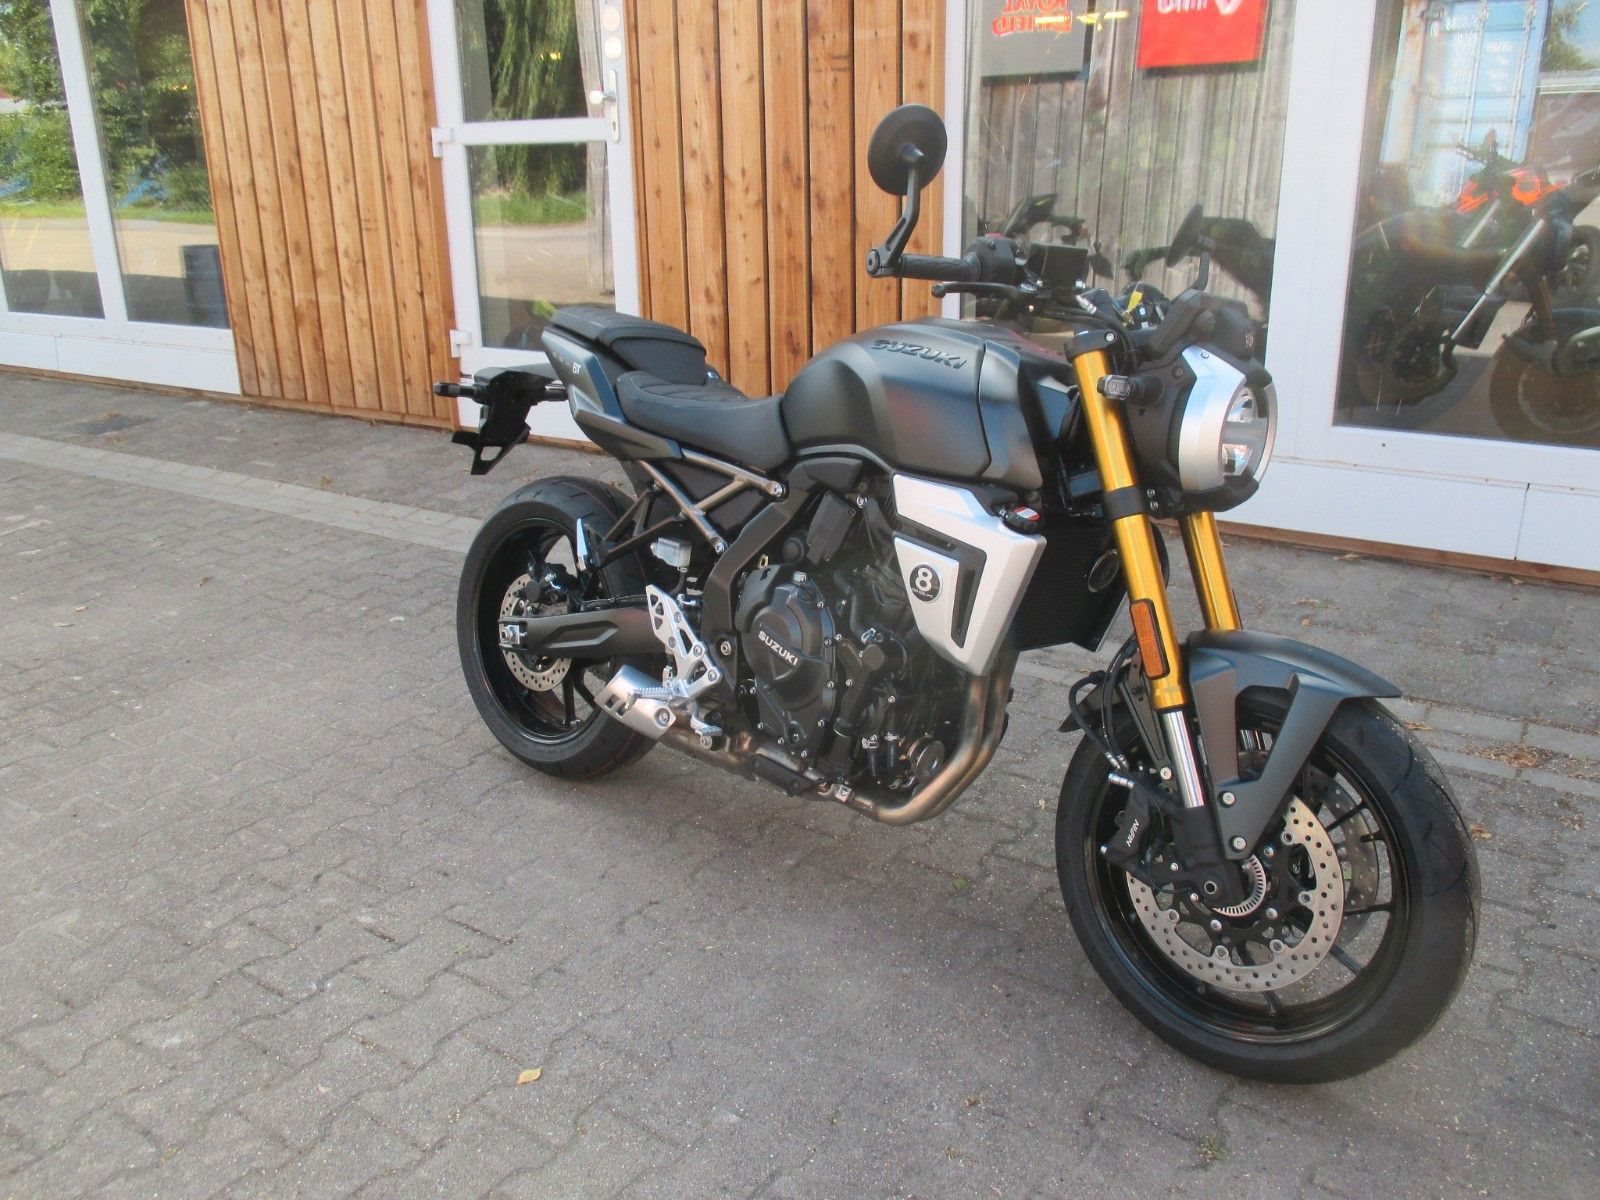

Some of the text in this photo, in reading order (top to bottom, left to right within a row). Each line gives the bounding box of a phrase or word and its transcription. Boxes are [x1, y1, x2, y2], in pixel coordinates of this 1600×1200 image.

[871, 339, 968, 370] SUZUKI
[915, 567, 933, 592] 8
[758, 630, 799, 666] SUZUKI
